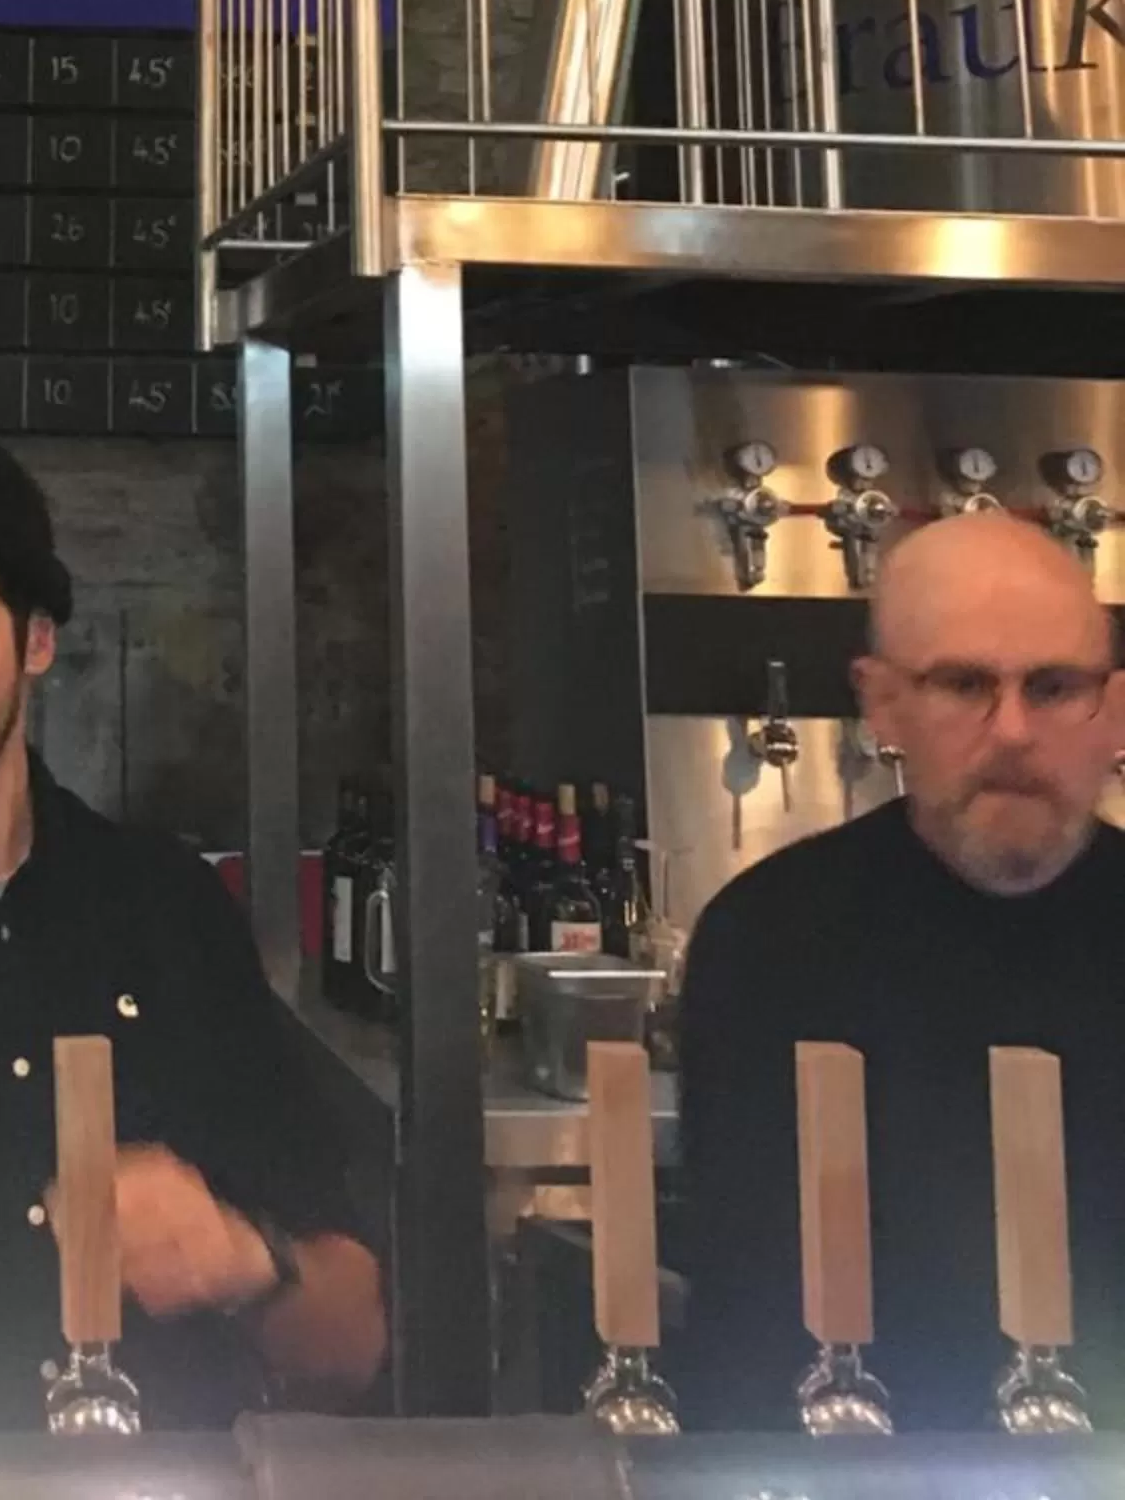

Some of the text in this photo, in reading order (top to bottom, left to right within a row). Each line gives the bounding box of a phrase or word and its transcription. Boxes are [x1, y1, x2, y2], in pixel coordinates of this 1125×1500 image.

[50, 55, 81, 85] 15
[50, 135, 83, 162] 10
[43, 378, 74, 407] 10
